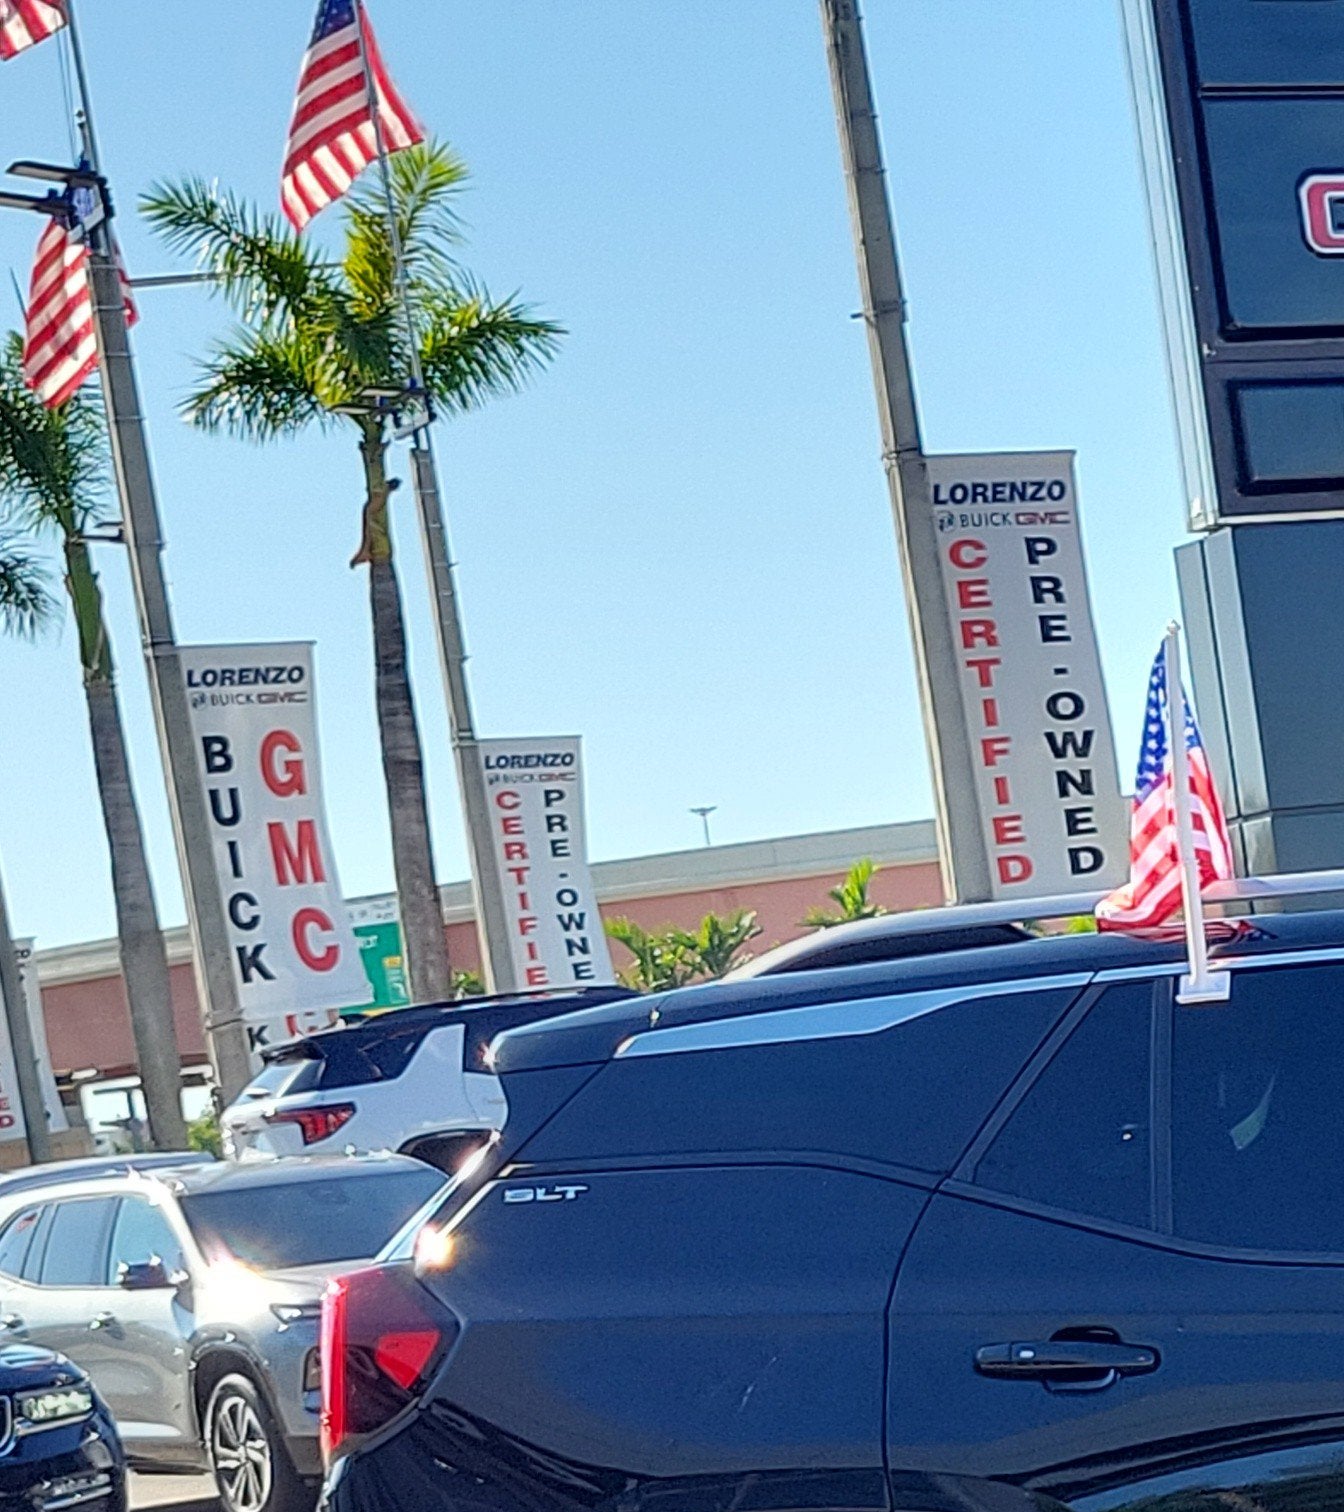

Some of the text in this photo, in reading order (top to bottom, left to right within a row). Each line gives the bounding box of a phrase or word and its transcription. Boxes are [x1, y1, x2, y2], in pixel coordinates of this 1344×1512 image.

[933, 480, 1066, 505] LORENZO
[959, 511, 1071, 528] BUICK GMC
[186, 666, 305, 688] LORENZO
[948, 539, 1033, 886] CERTIFIED
[1024, 537, 1104, 876] PRE-OWNED
[485, 752, 574, 770] LORENZO
[201, 734, 277, 984] BUICK
[260, 729, 341, 973] GMC
[495, 790, 550, 997] CERTIFIE
[504, 1186, 588, 1203] SLT
